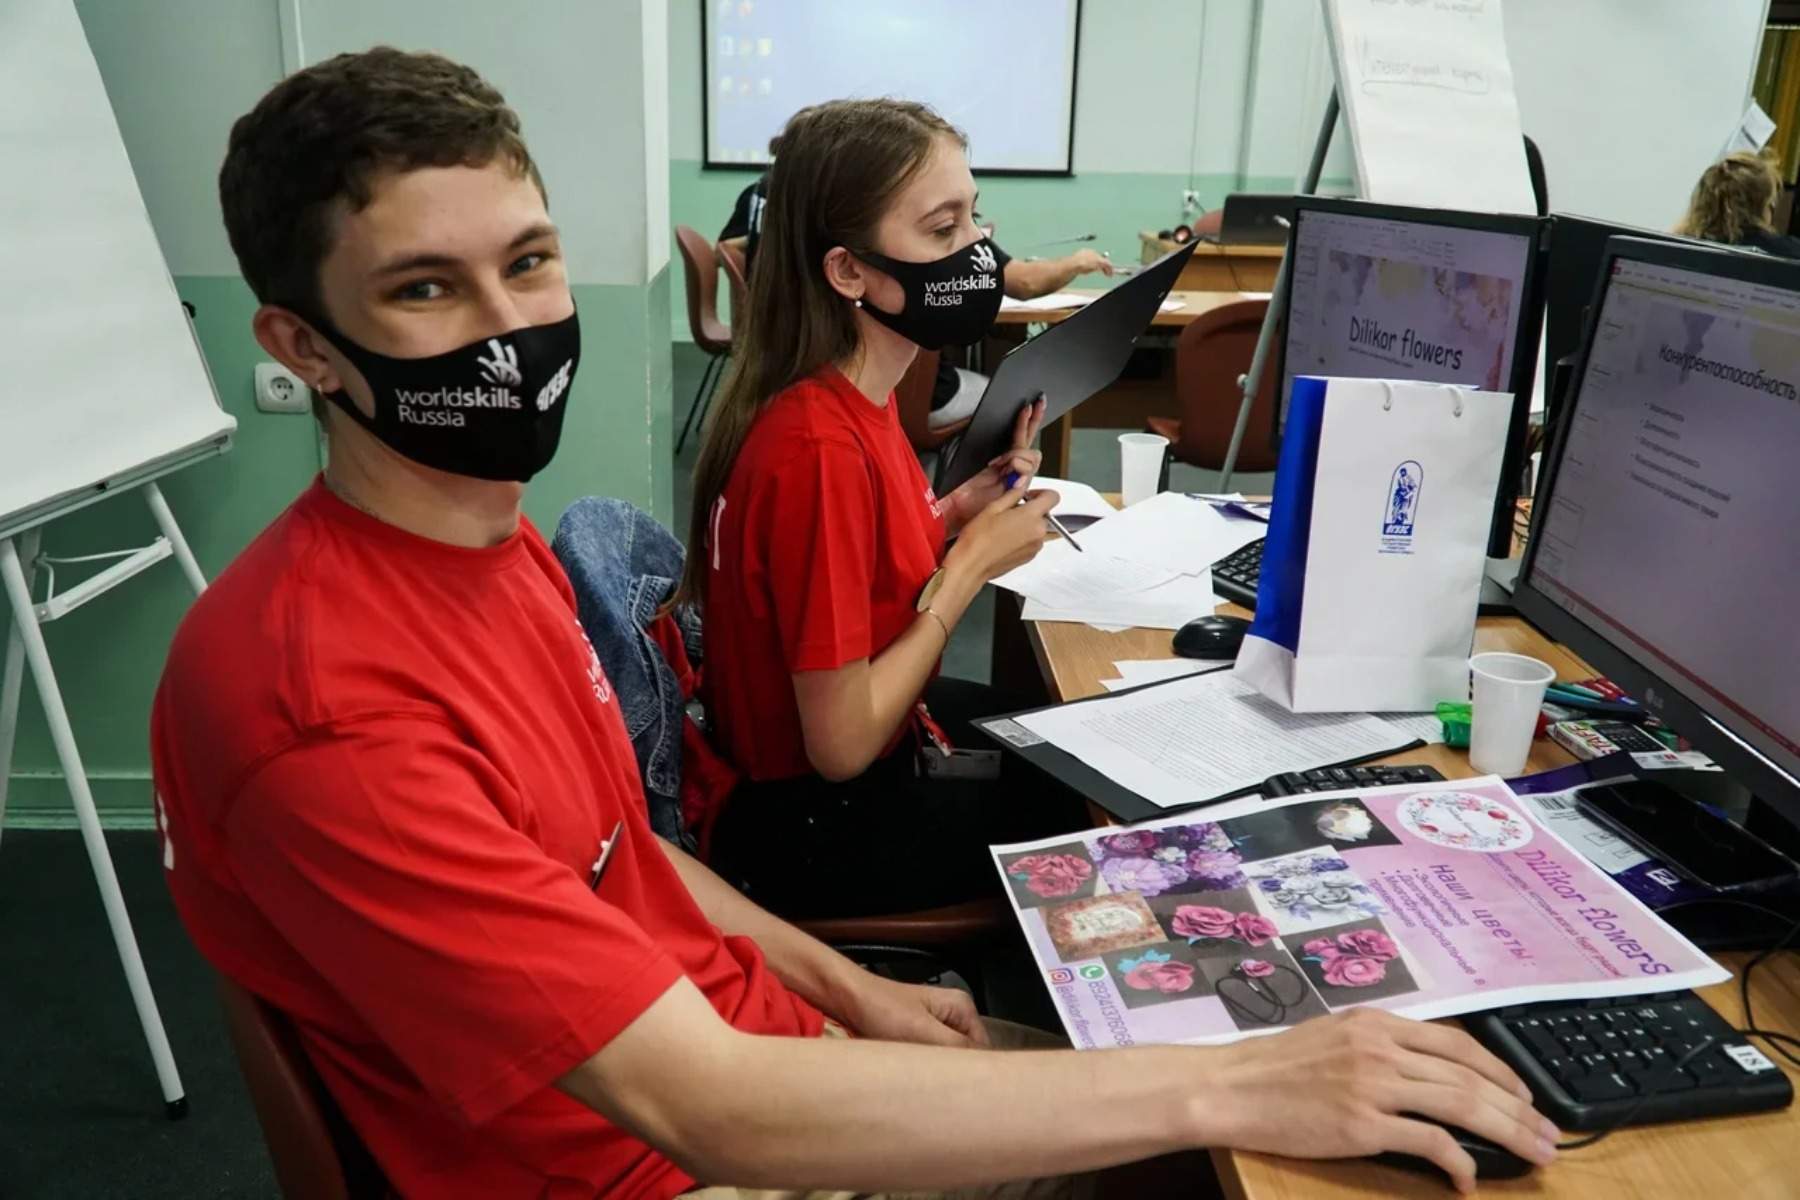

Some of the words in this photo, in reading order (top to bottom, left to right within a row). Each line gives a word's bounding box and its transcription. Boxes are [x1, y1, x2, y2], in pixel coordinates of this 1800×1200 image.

[924, 274, 997, 292] worldskills
[924, 292, 963, 306] Russia
[1349, 315, 1398, 351] Dilikor
[1401, 328, 1463, 370] flowers
[1659, 343, 1798, 401] Конкурентоспособность
[394, 385, 523, 409] worldskills
[398, 404, 466, 427] Russia
[1429, 864, 1475, 901] Наши
[1514, 849, 1587, 902] Dilikor
[1577, 907, 1675, 976] flowers
